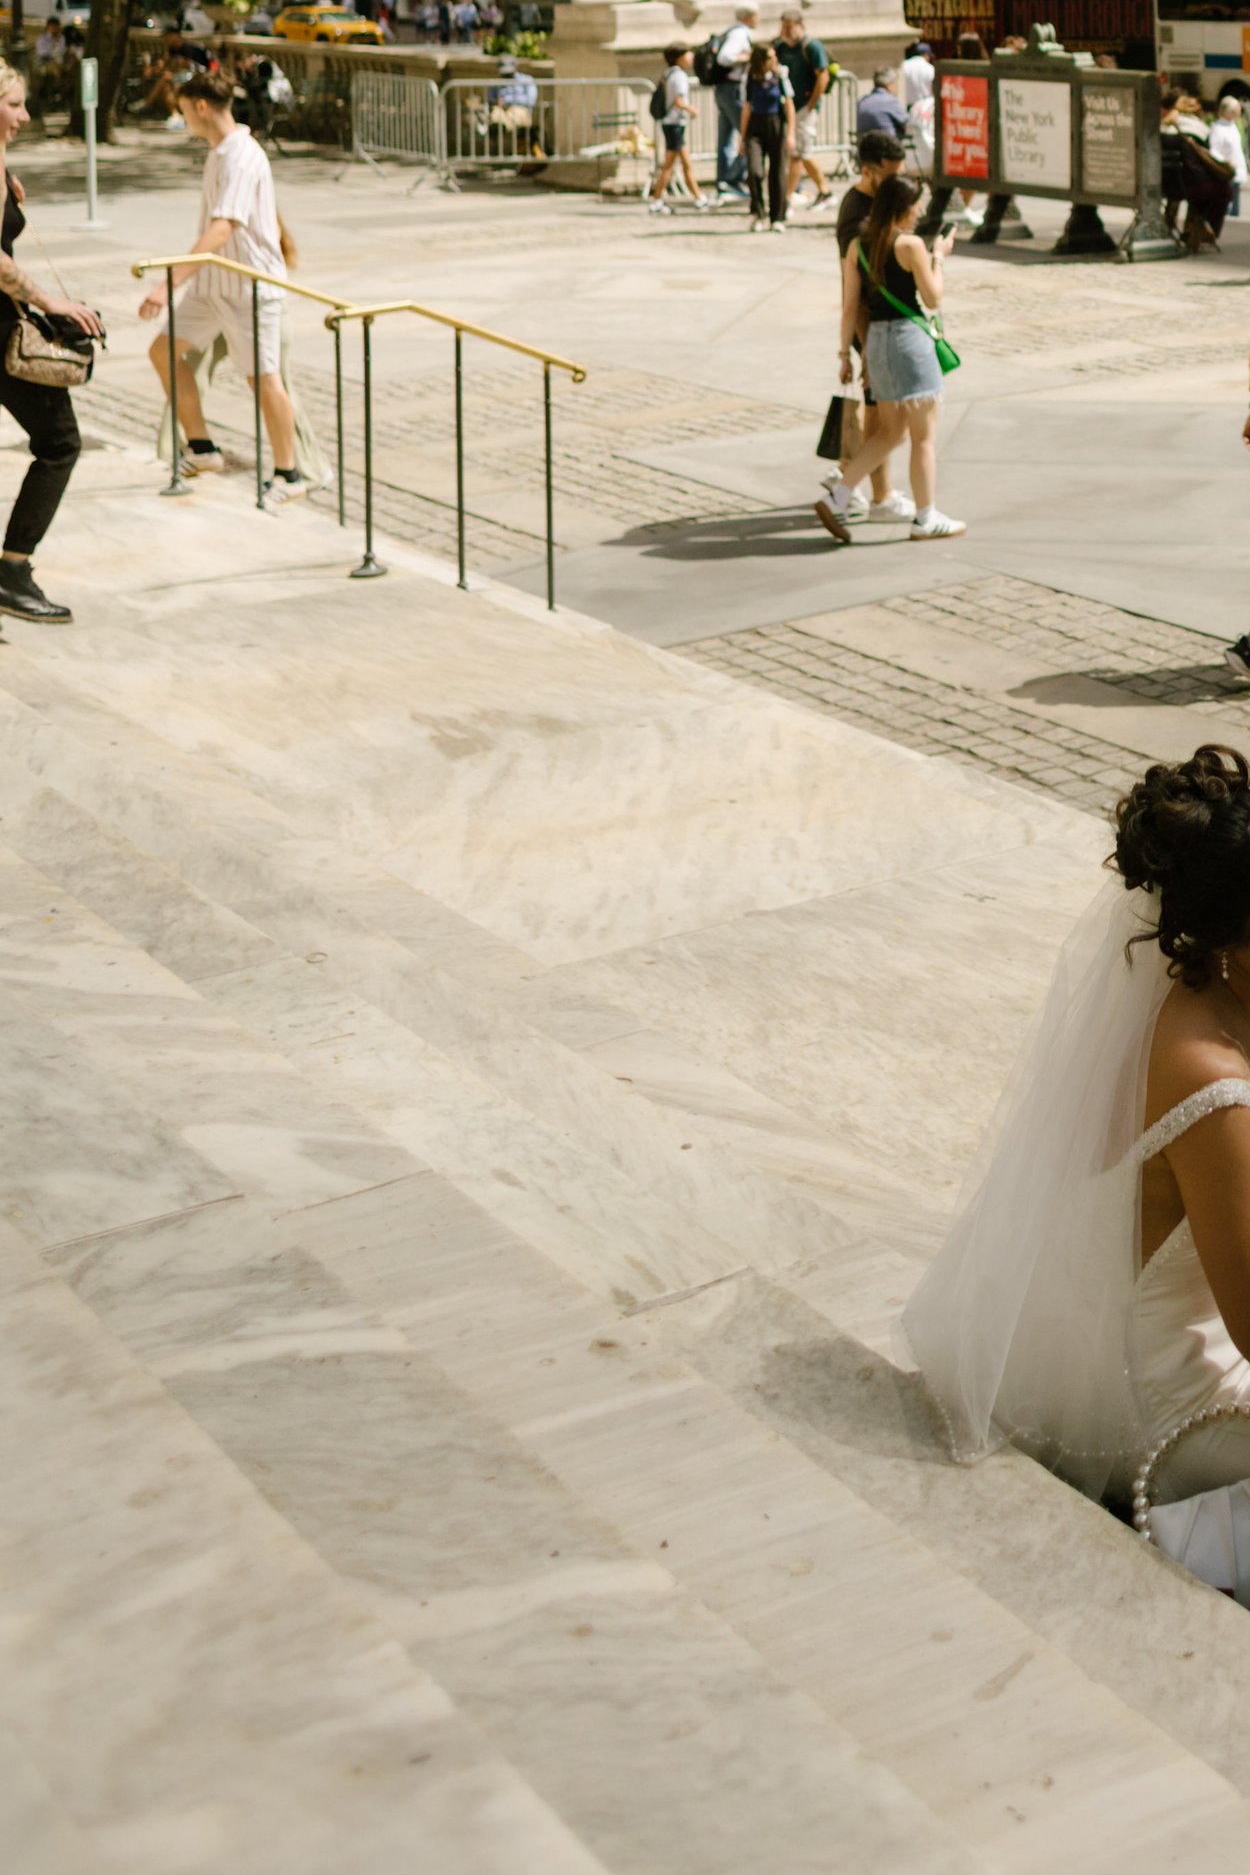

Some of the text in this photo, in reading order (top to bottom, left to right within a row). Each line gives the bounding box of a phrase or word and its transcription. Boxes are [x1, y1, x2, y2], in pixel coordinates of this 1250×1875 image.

[1004, 88, 1024, 107] The
[1084, 94, 1120, 111] Visit Us
[945, 100, 985, 126] Library
[1005, 108, 1055, 128] New York
[1084, 111, 1134, 128] Across the
[1007, 126, 1039, 145] Public
[1085, 127, 1114, 143] Street
[1008, 145, 1046, 169] Library
